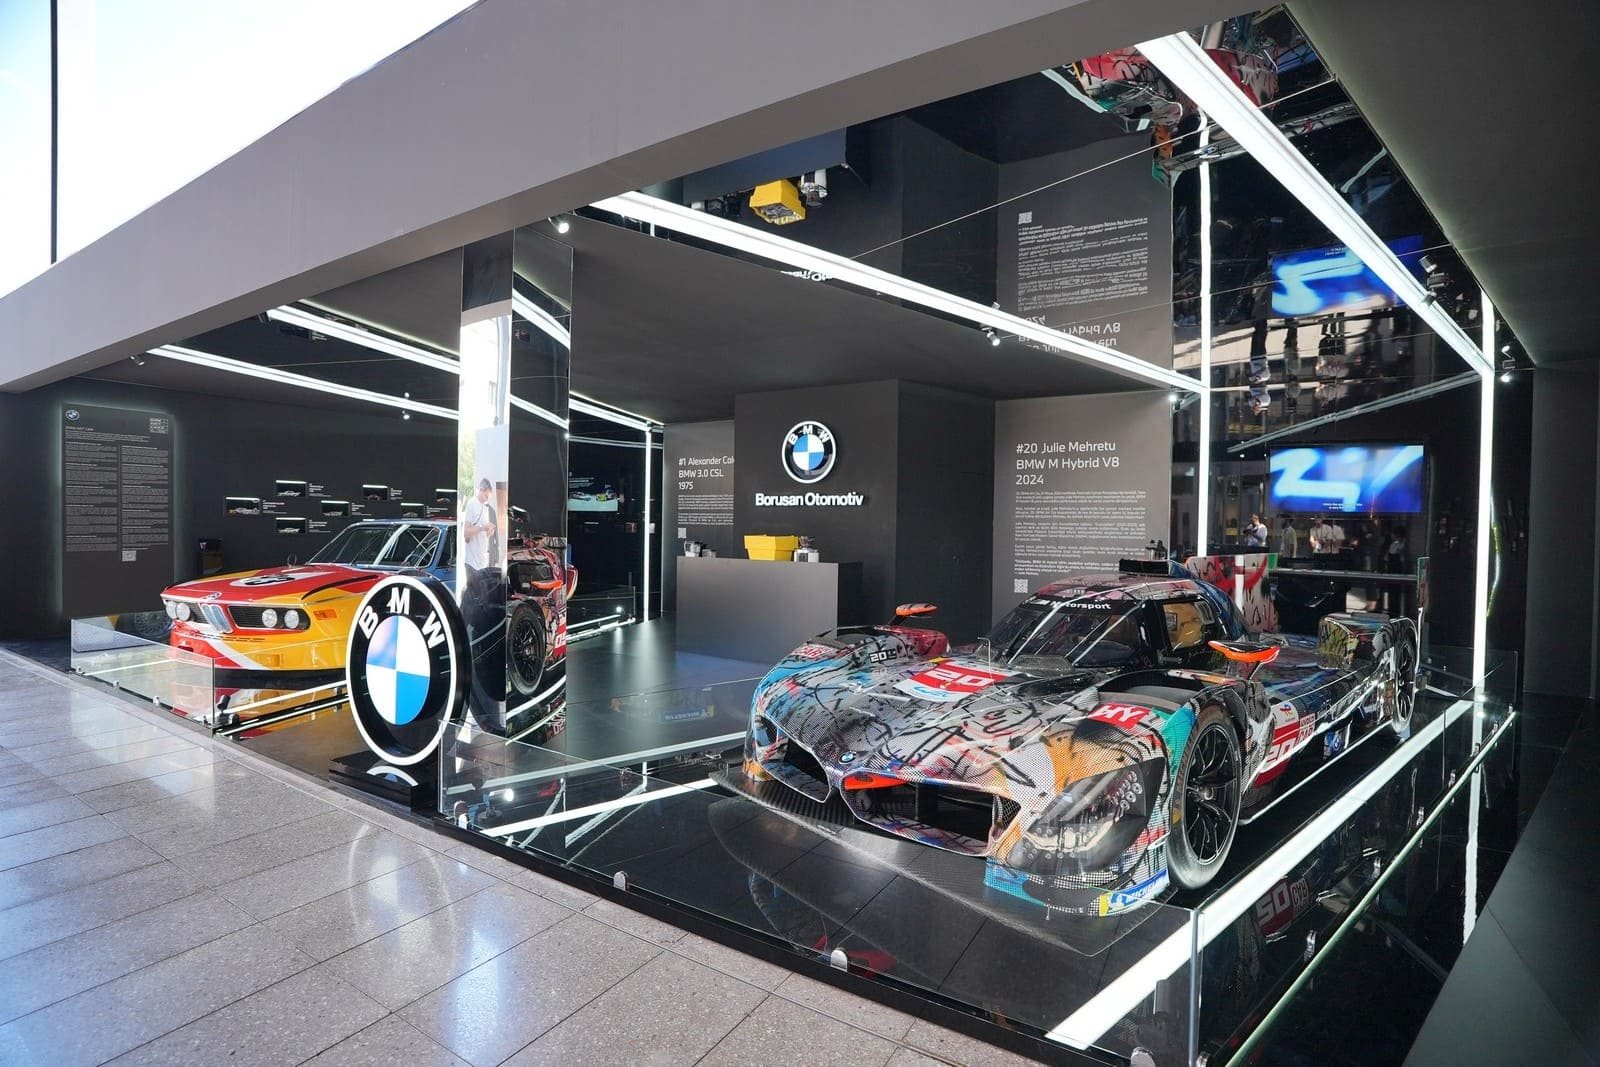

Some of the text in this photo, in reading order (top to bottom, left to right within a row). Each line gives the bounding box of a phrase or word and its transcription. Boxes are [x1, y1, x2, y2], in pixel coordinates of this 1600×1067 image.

[788, 424, 830, 445] BMW
[1016, 441, 1116, 454] #20 Julie Mehretu
[678, 455, 735, 466] #1 Alexander Cal
[1016, 456, 1120, 470] BMW M Hybrid V8
[678, 468, 724, 478] BMW 3.0 CSL
[1016, 474, 1044, 485] 2024
[678, 481, 694, 490] 1975
[755, 491, 864, 506] Borusan Otomotiv
[358, 586, 446, 649] BMW
[869, 651, 887, 663] 20
[923, 668, 994, 687] 20
